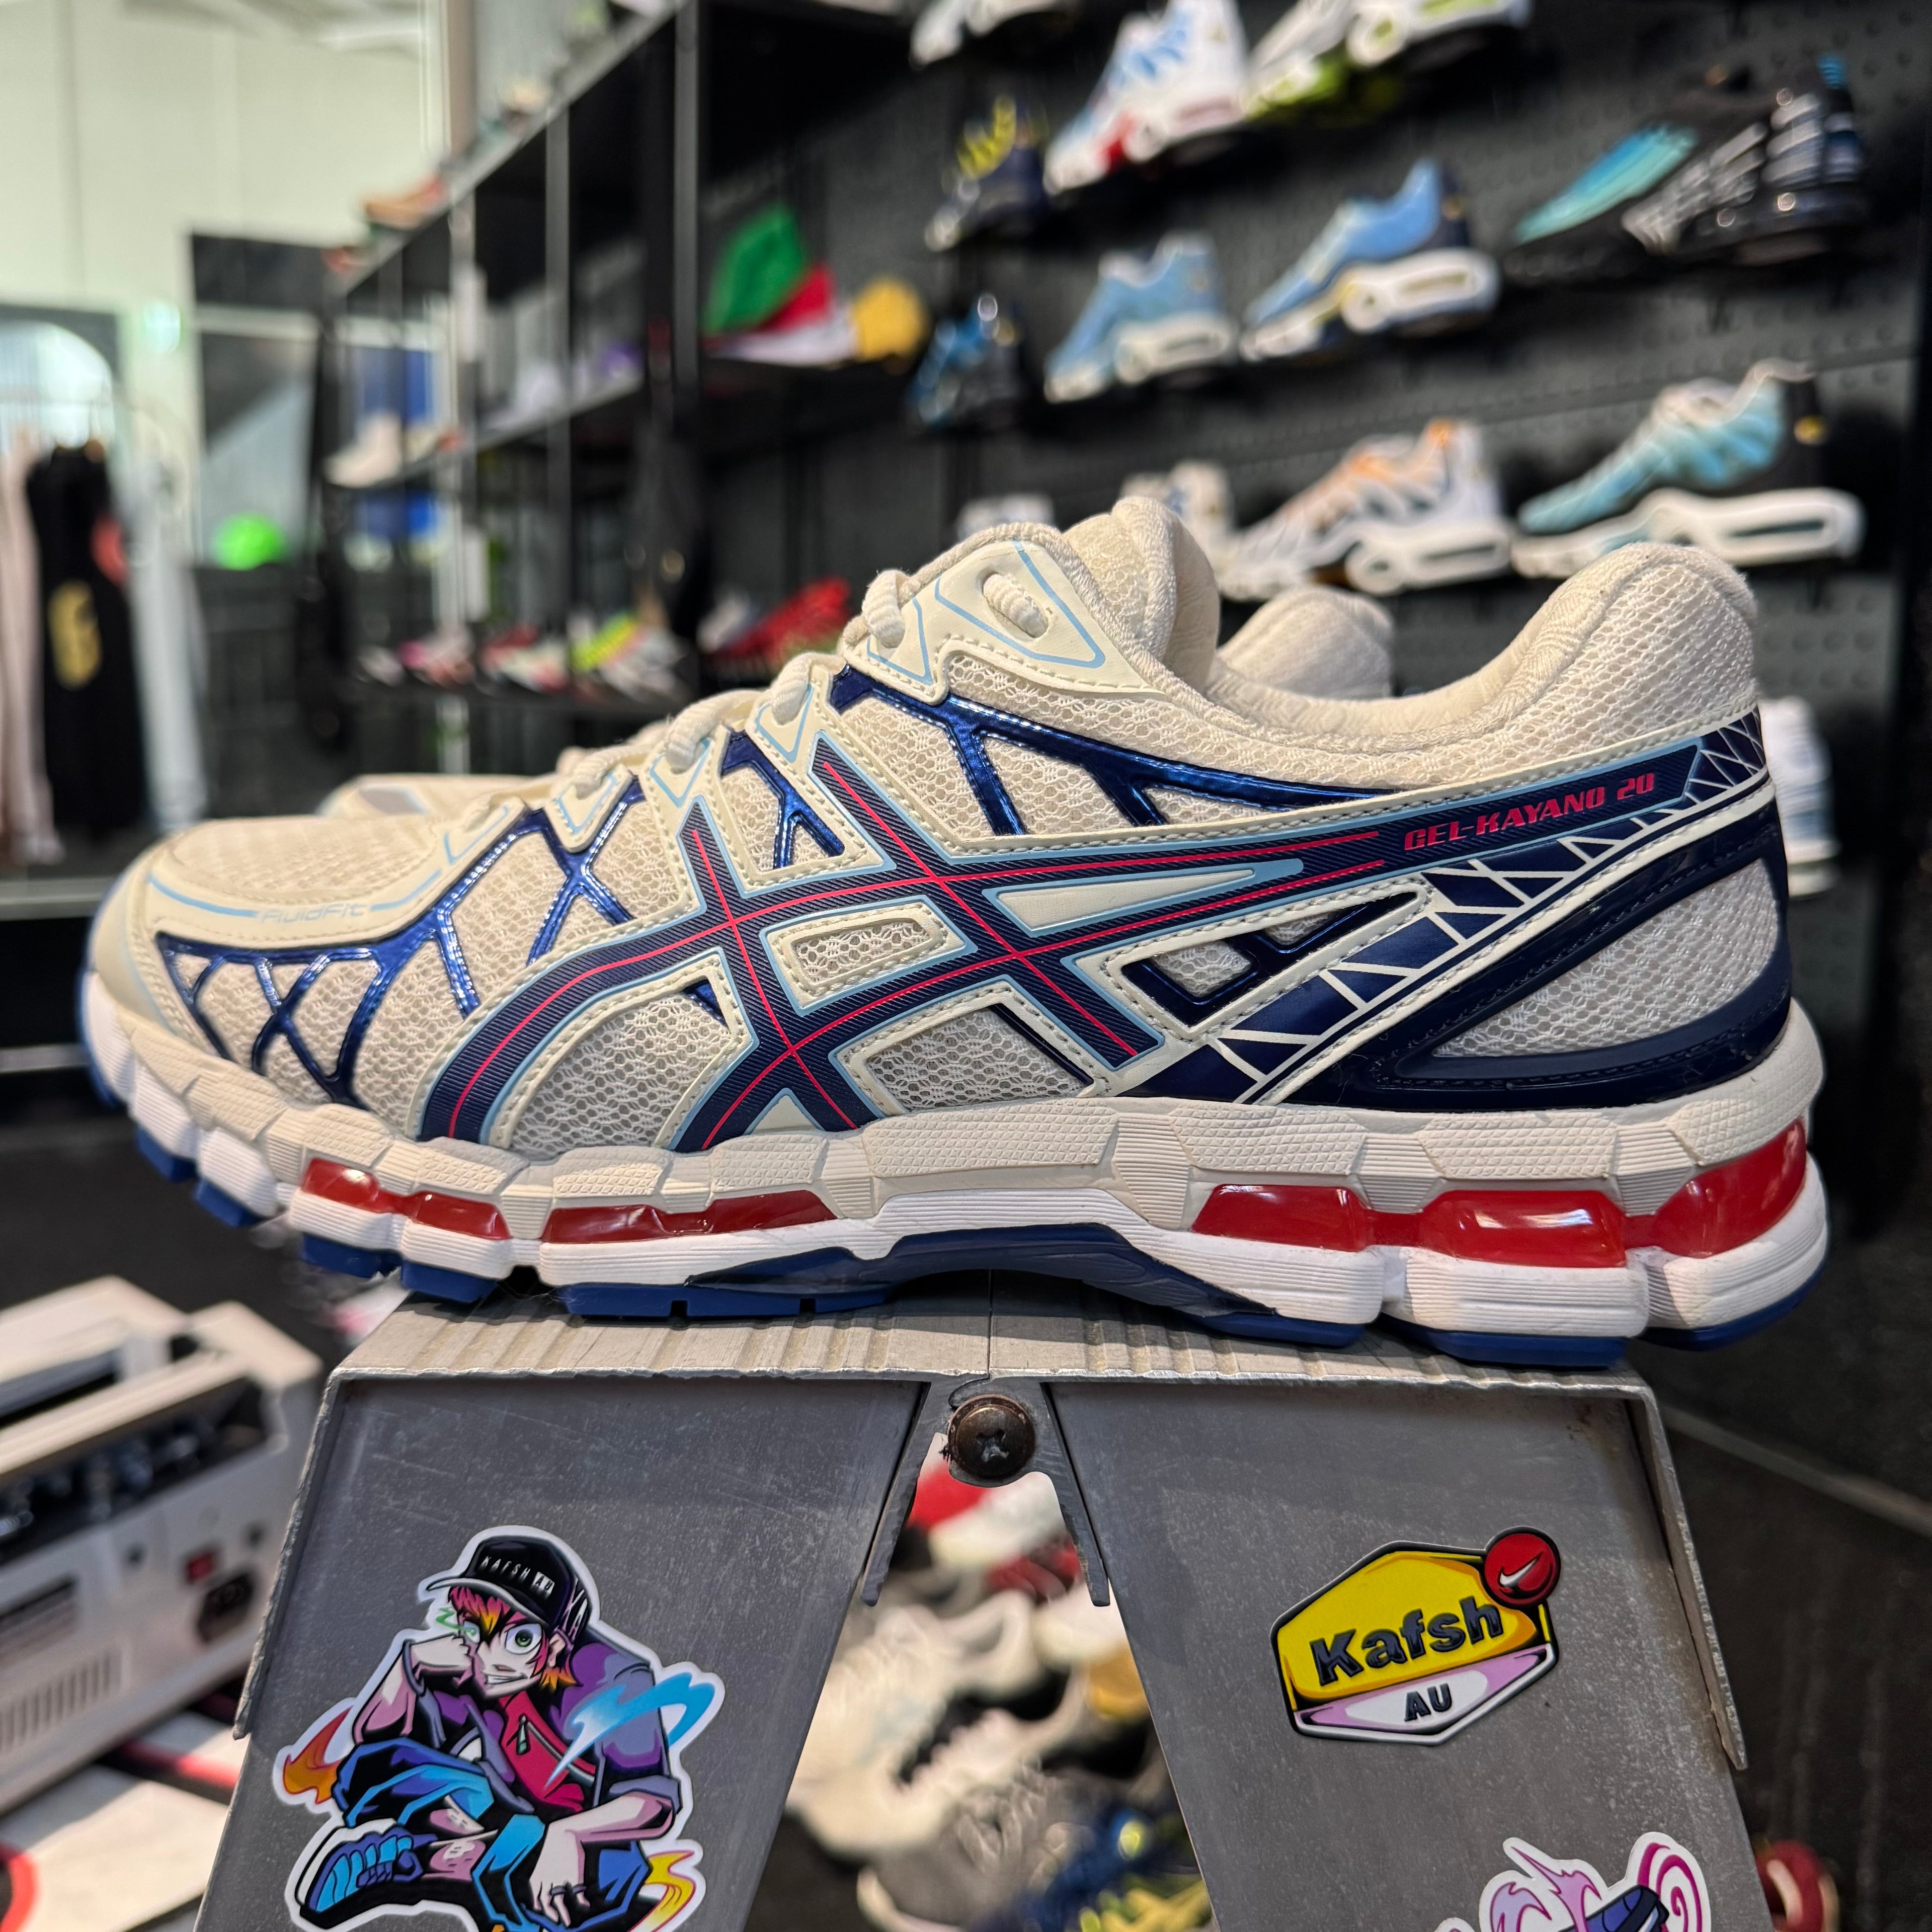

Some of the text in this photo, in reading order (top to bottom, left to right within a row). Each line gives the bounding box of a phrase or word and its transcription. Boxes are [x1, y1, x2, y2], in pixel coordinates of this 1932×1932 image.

[1404, 772, 1655, 851] GEL-KAYANO 20
[479, 1556, 553, 1592] KAFSH AU
[1310, 1595, 1504, 1686] Kafsh
[1404, 1682, 1453, 1722] AU
